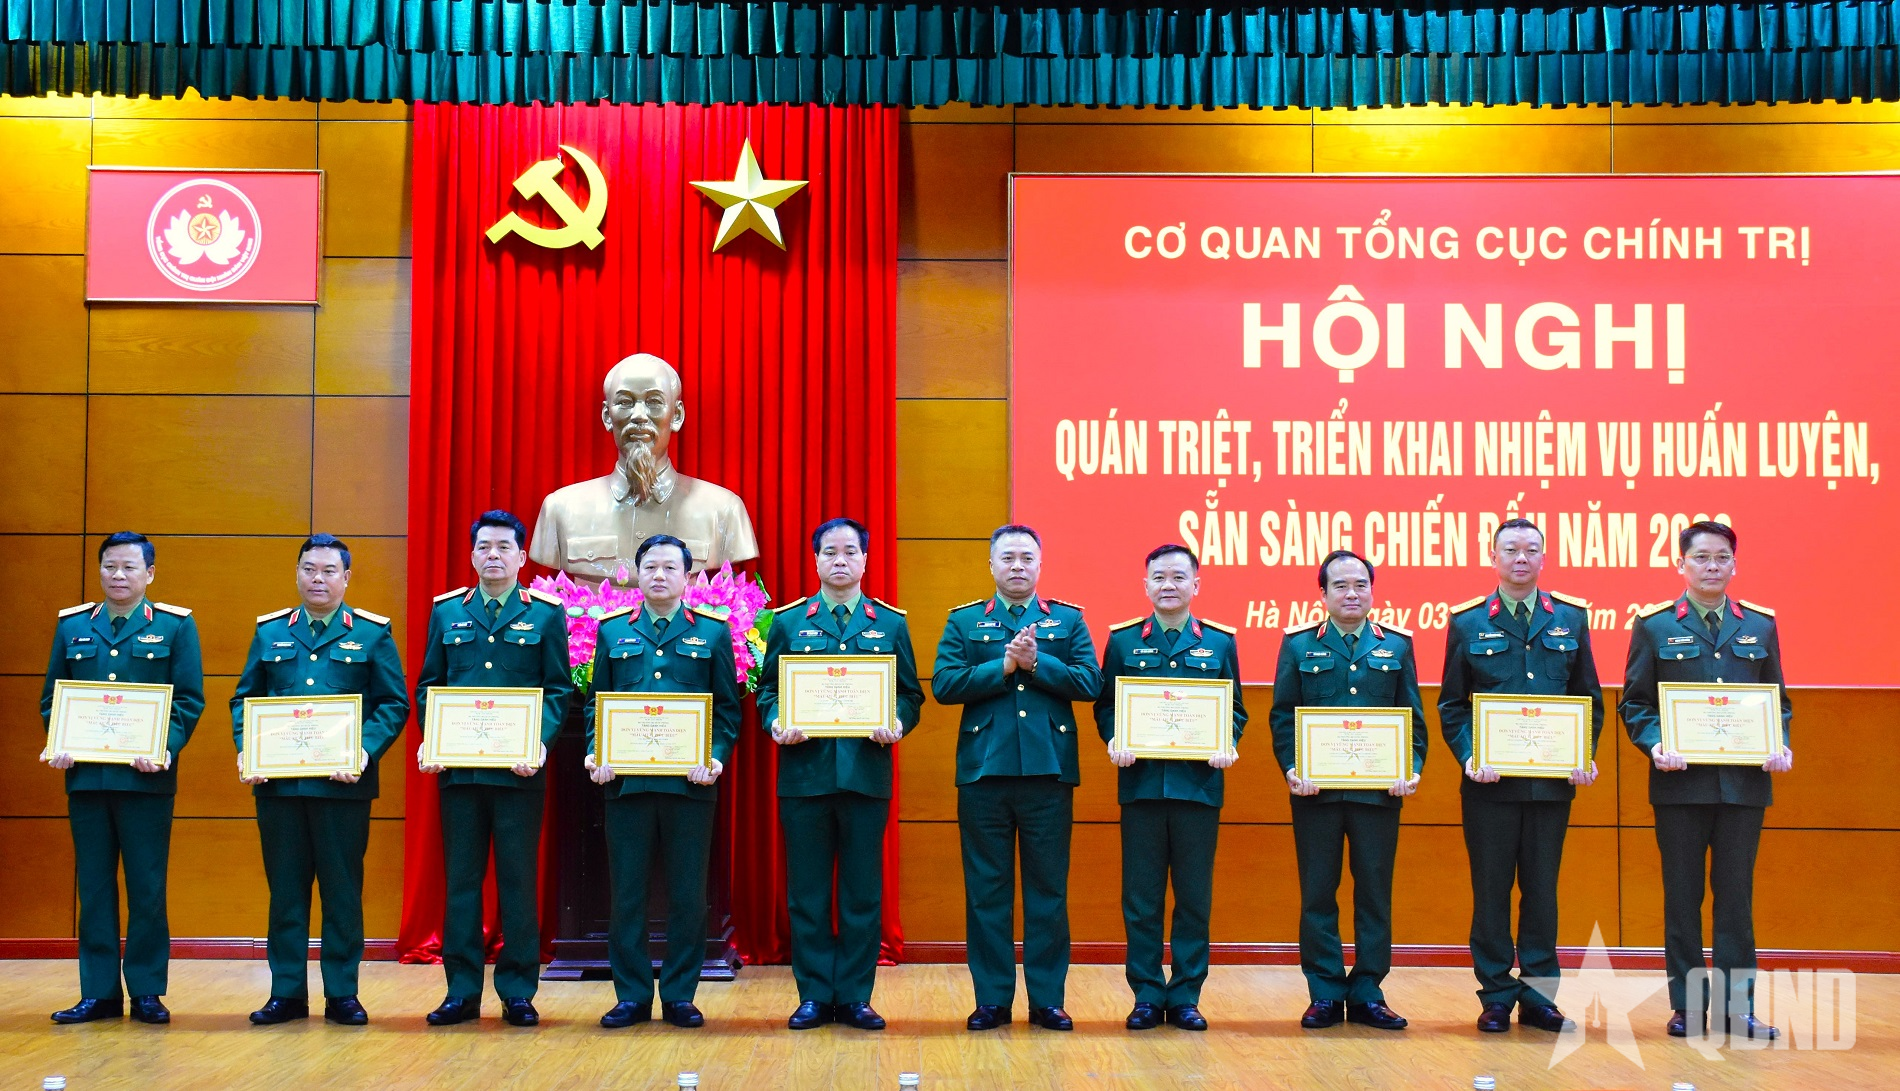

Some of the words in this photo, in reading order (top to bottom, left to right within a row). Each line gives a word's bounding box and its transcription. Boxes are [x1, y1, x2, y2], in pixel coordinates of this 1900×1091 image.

[1125, 222, 1186, 258] CƠ
[1201, 226, 1320, 260] QUAN
[1337, 209, 1458, 259] TỔNG
[1476, 227, 1567, 266] CỤC
[1584, 218, 1721, 259] CHÍNH
[1738, 227, 1809, 266] TRỊ
[1244, 285, 1404, 383] HỘI
[1445, 302, 1685, 384] NGHỊ
[1056, 408, 1147, 481] QUÁN
[1159, 409, 1261, 488] TRIỆT,
[1273, 398, 1371, 475] TRIỂN
[1384, 421, 1462, 475] KHAI
[1475, 410, 1586, 489] NHIỆM
[1598, 422, 1640, 489] VỤ
[1653, 402, 1746, 477] HUẤN
[1759, 410, 1879, 489] LUYỆN,
[1179, 490, 1247, 565] SẴN
[1260, 499, 1352, 566] SÀNG
[1364, 494, 1467, 567] CHIẾN
[1558, 501, 1637, 567] NĂM
[1649, 513, 1732, 567] 20
[1246, 601, 1279, 628] Hà
[1418, 602, 1448, 629] 03
